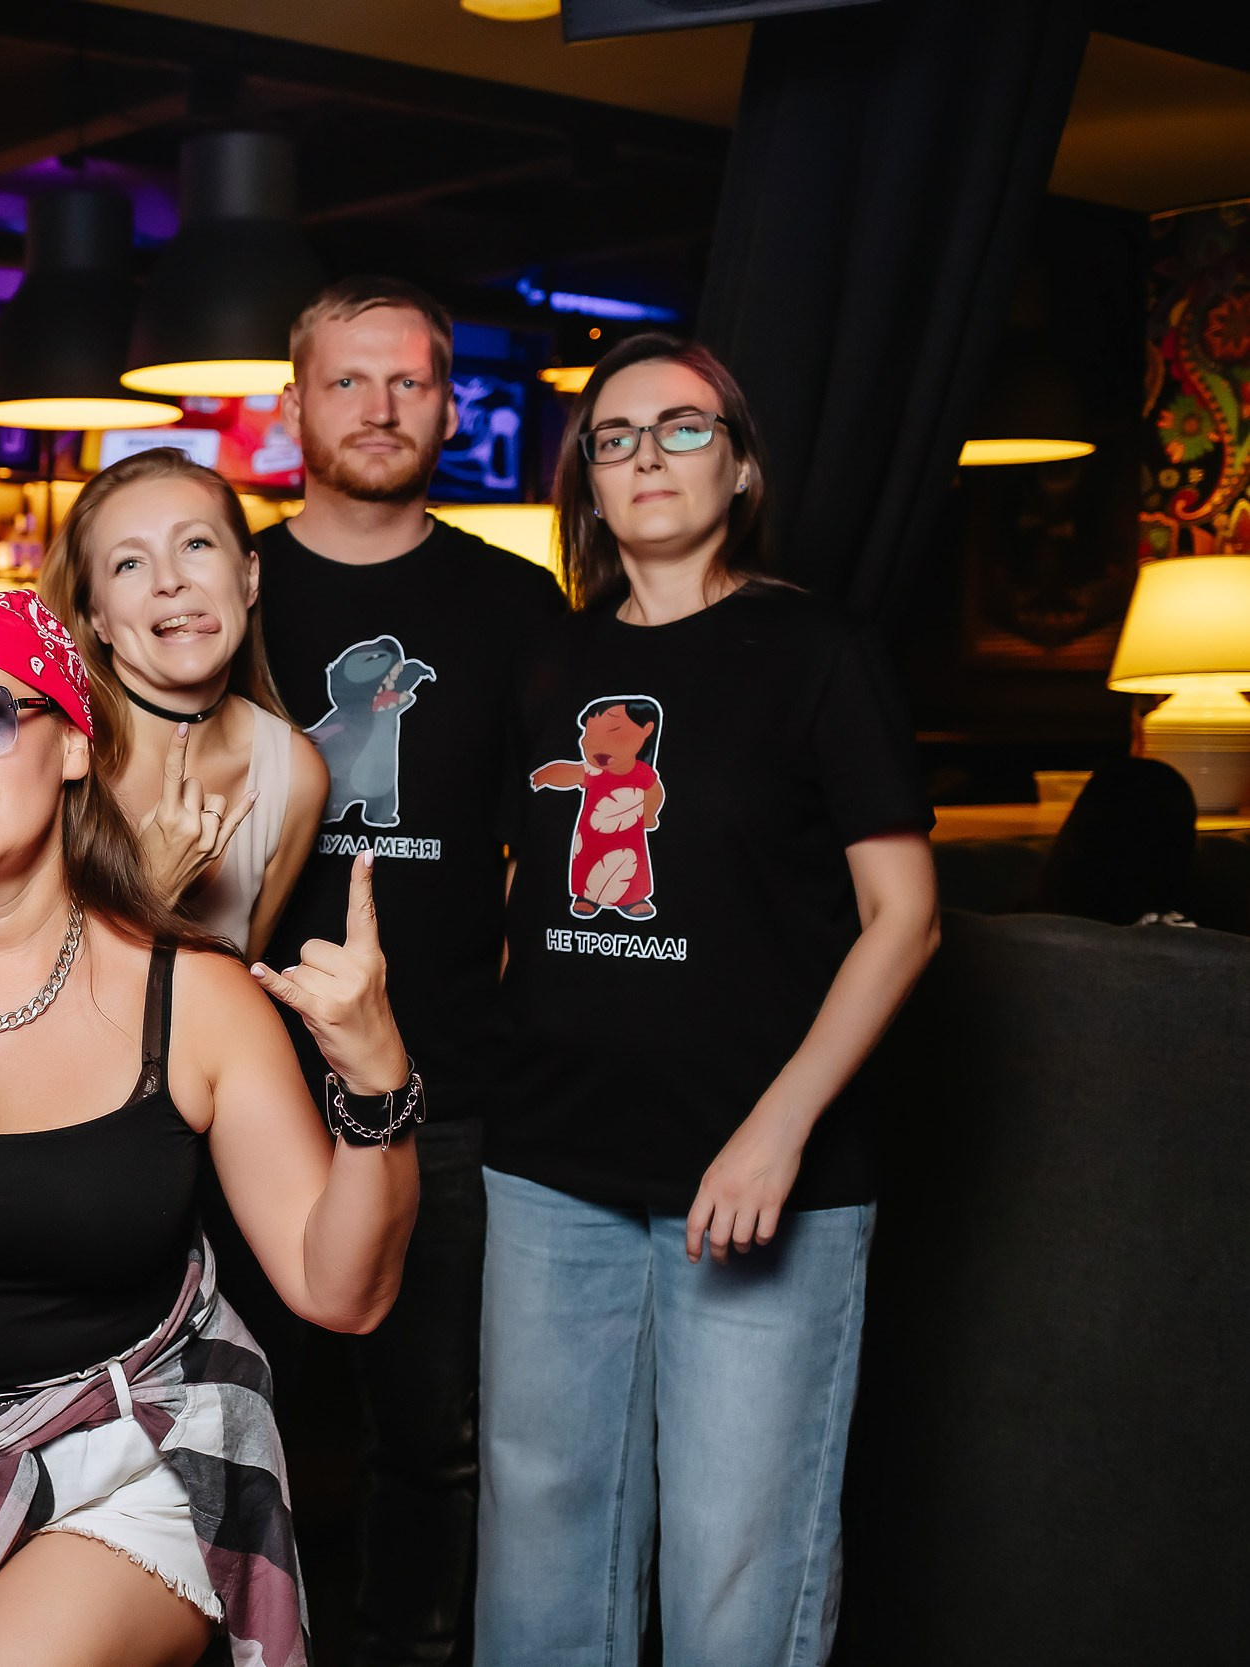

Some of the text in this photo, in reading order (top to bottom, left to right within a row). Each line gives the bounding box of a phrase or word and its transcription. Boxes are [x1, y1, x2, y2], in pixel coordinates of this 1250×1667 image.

[373, 836, 441, 860] МЕНЯ!
[546, 928, 687, 961] НЕ ТРОГАЛА!
